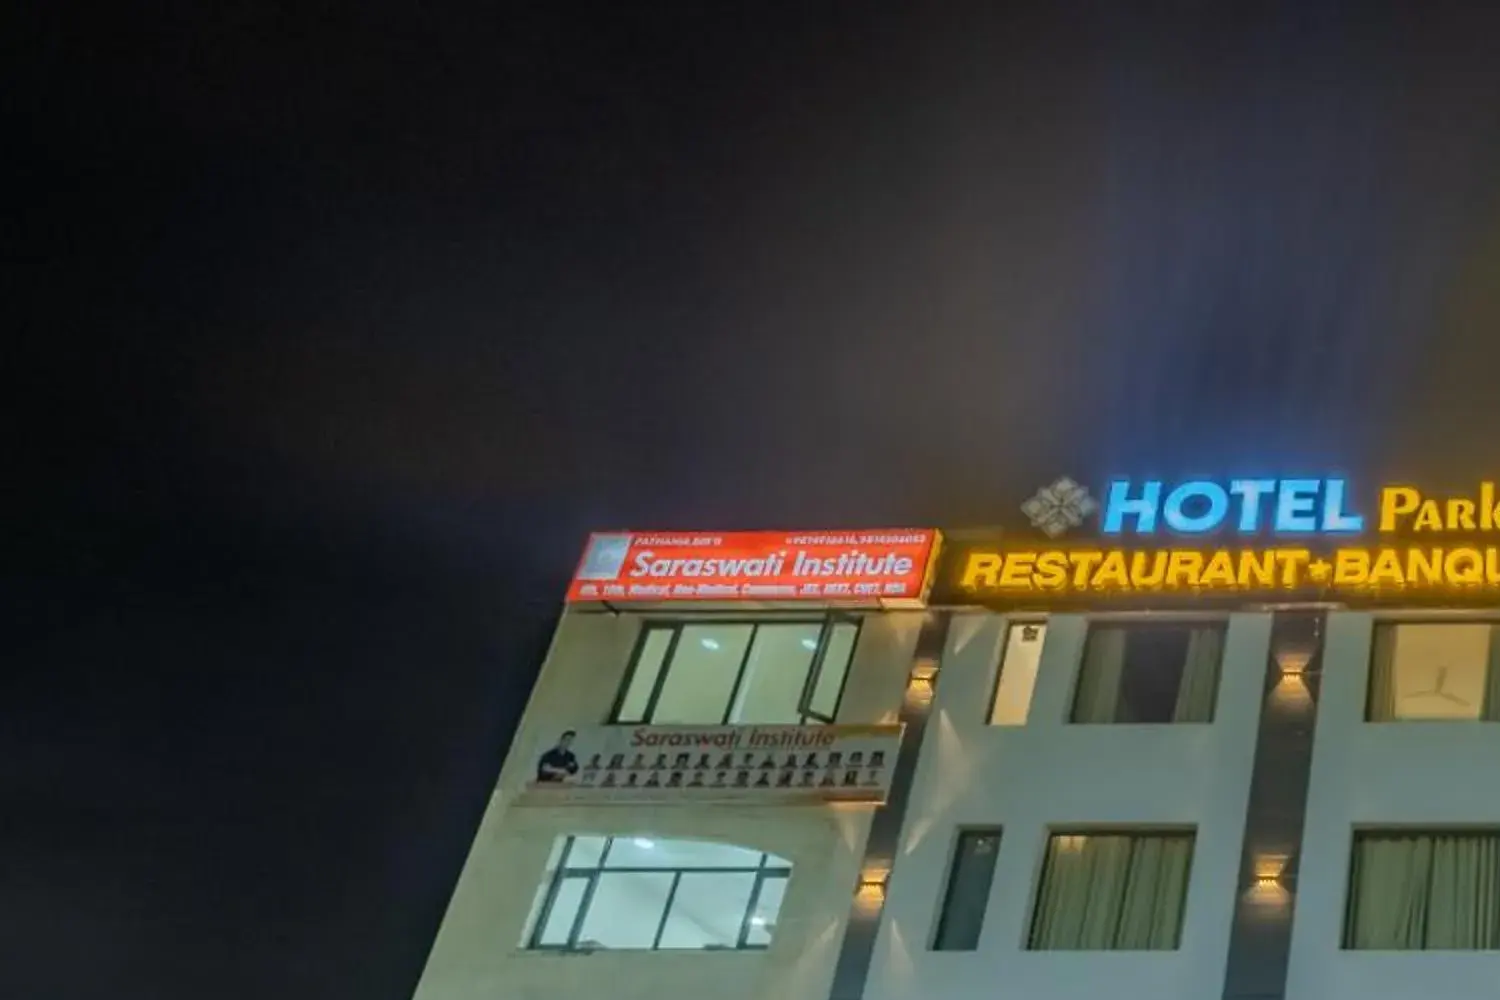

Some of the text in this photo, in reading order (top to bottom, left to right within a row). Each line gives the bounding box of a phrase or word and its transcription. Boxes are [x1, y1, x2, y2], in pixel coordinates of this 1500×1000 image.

[1103, 478, 1364, 535] HOTEL
[629, 549, 913, 577] Saraswati Institute
[960, 548, 1309, 589] RESTAURANT
[630, 727, 837, 748] Saraswati Institute
